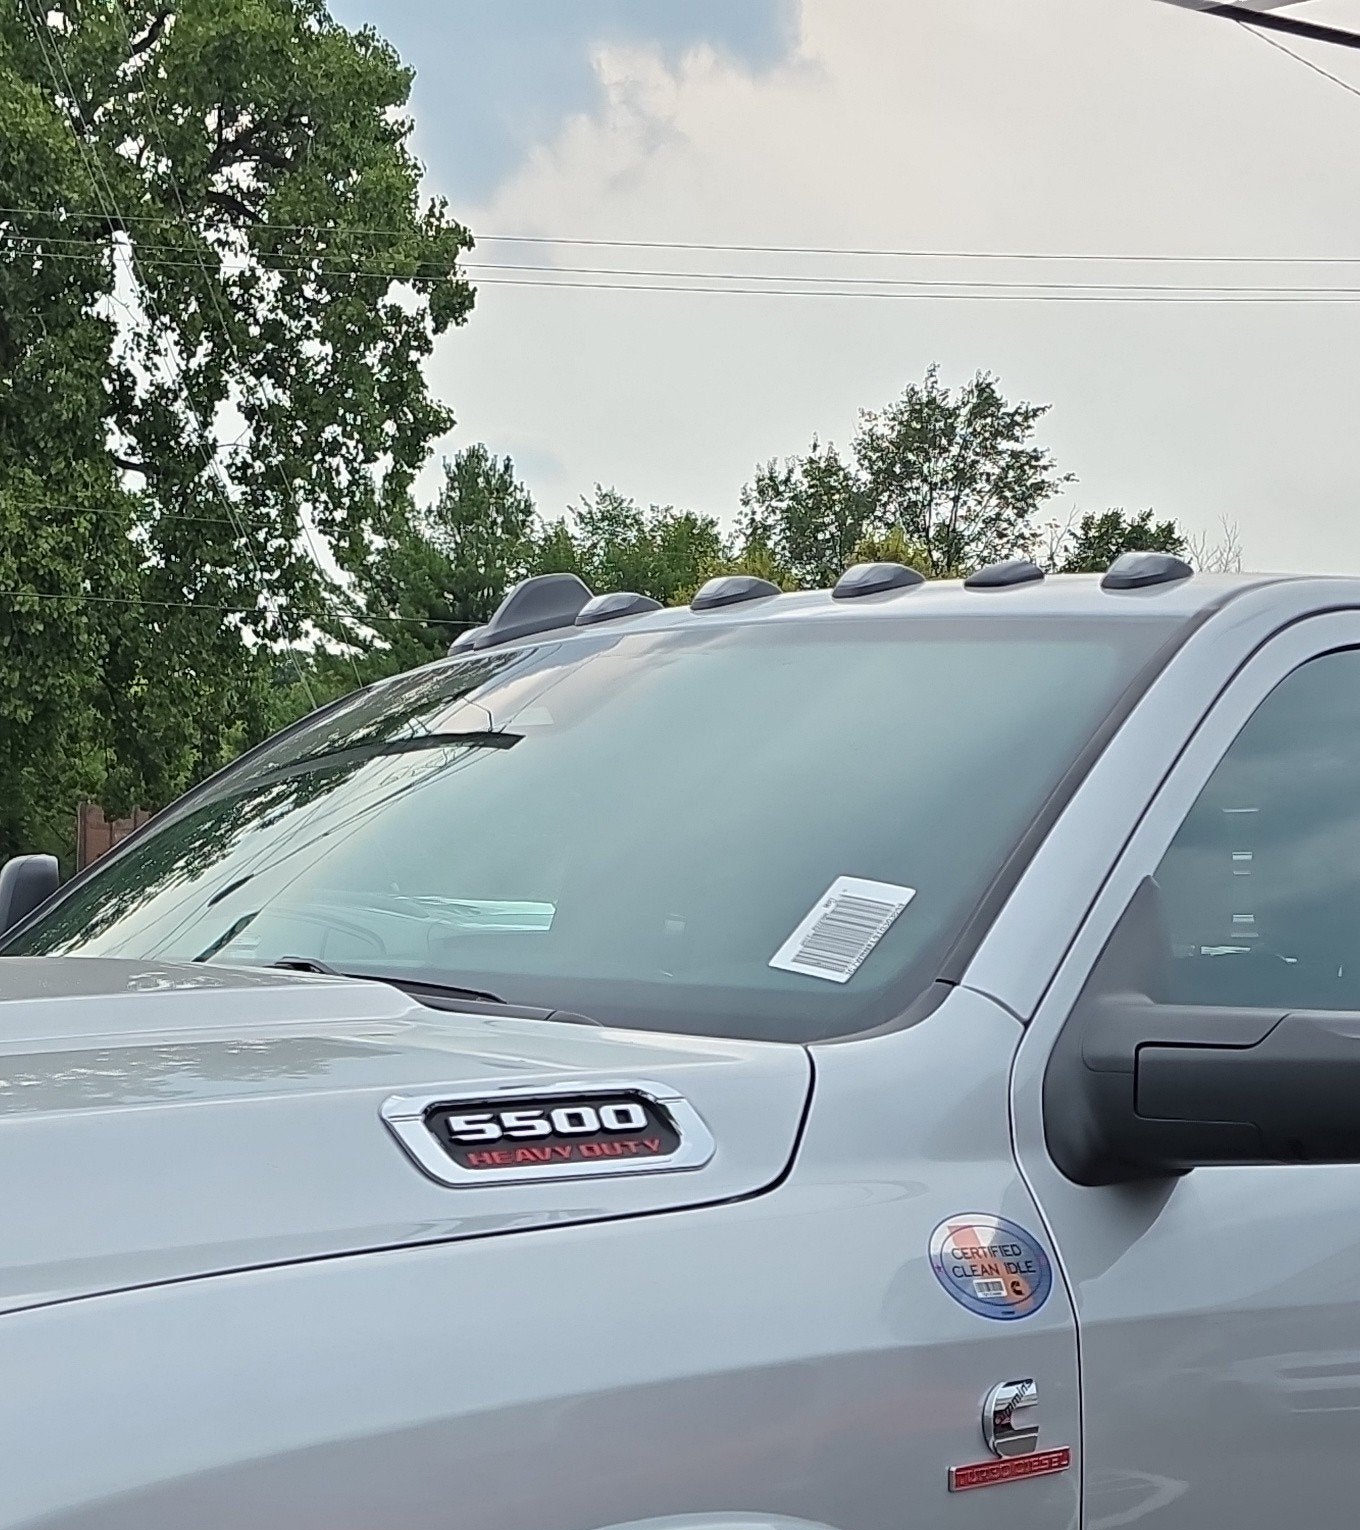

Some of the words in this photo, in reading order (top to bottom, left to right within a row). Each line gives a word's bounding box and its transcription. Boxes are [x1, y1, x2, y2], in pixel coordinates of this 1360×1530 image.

[447, 1103, 648, 1143] 5500
[466, 1145, 572, 1167] HEAVY
[579, 1138, 662, 1159] DUTY
[951, 1243, 1022, 1260] CERTIFIED
[951, 1263, 1001, 1278] CLEAN
[1003, 1260, 1037, 1275] IDLE
